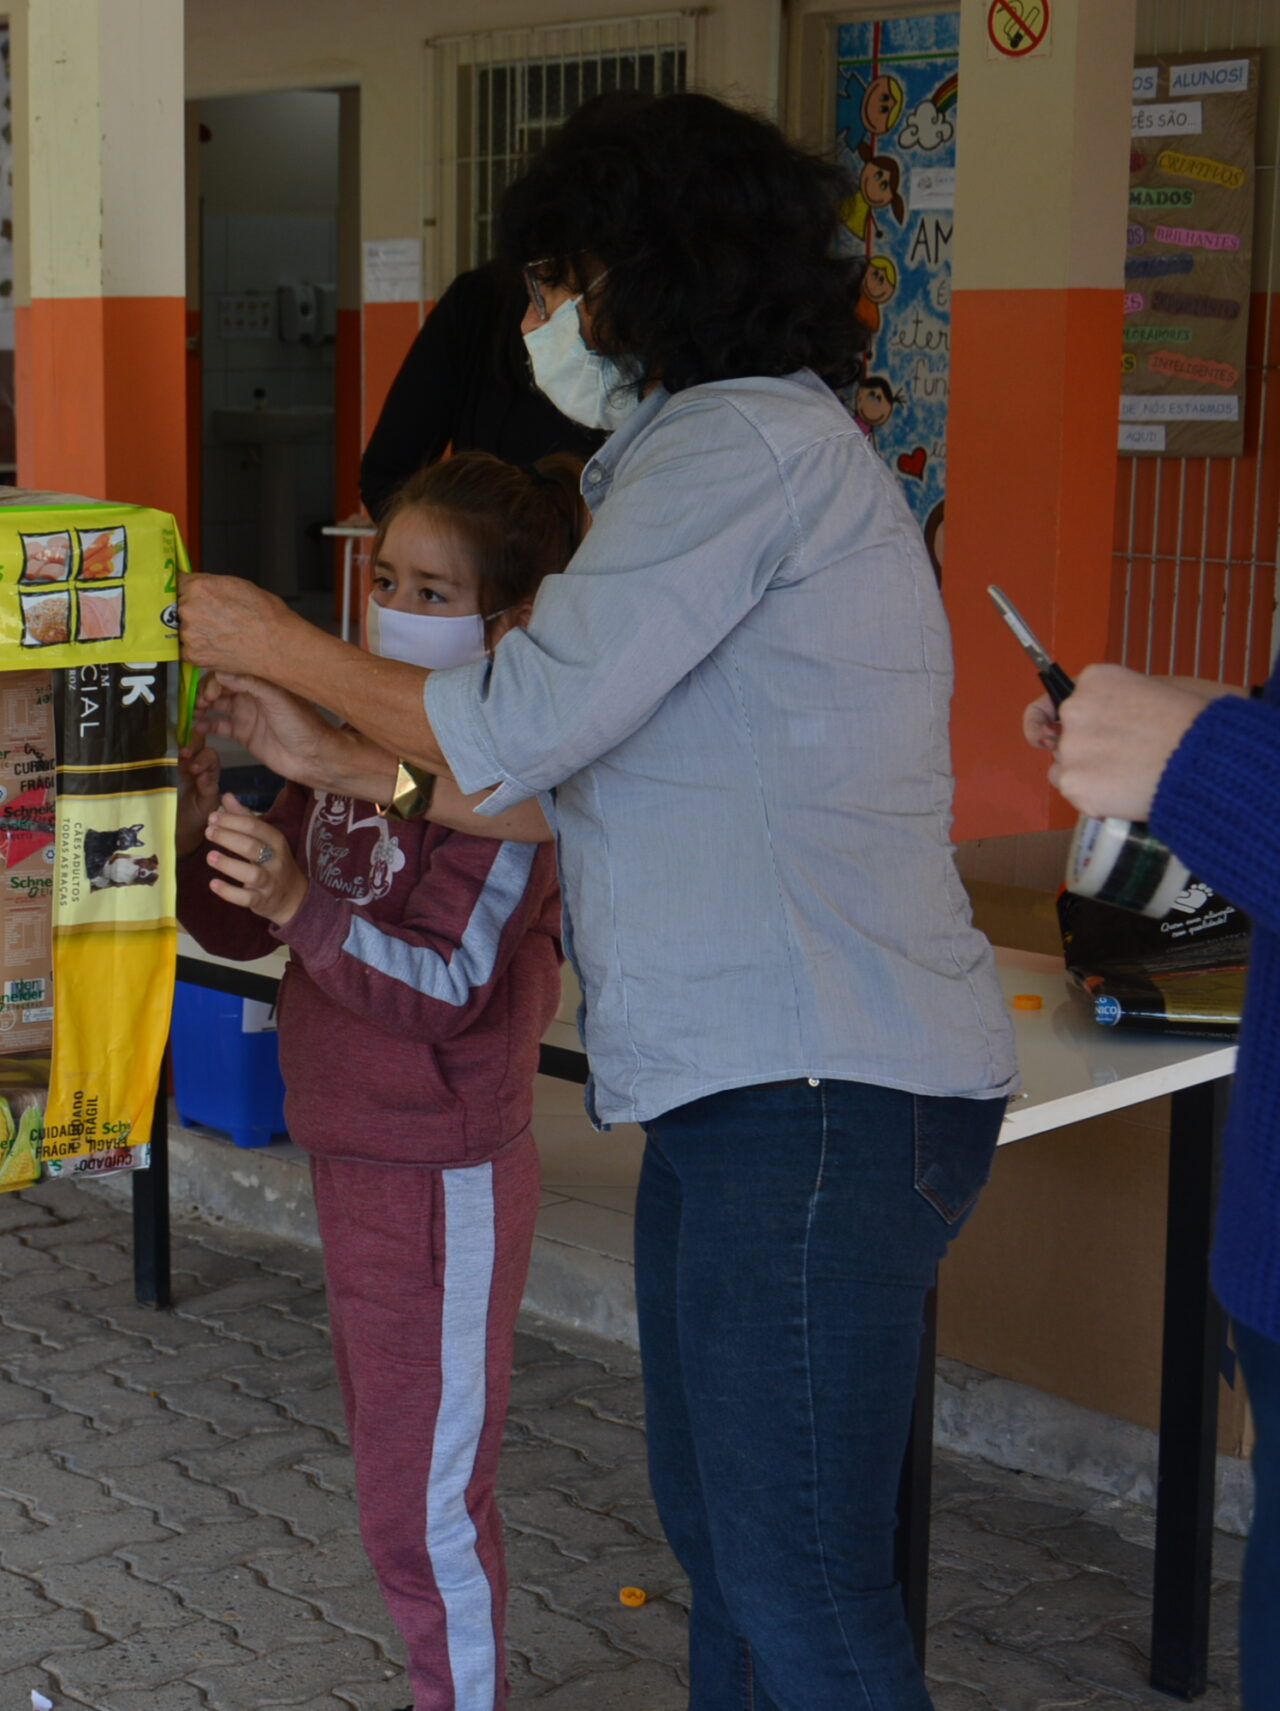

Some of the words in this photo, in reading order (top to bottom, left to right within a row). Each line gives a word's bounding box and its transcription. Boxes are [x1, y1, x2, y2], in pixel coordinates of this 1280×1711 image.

[1172, 67, 1243, 89] ALUNOS!
[61, 817, 71, 853] TODAS
[72, 822, 83, 850] CÃES
[61, 856, 69, 870] AS
[71, 853, 81, 903] ADULTOS
[58, 872, 68, 907] RAÇAS
[85, 1095, 98, 1143] FRÁGIL
